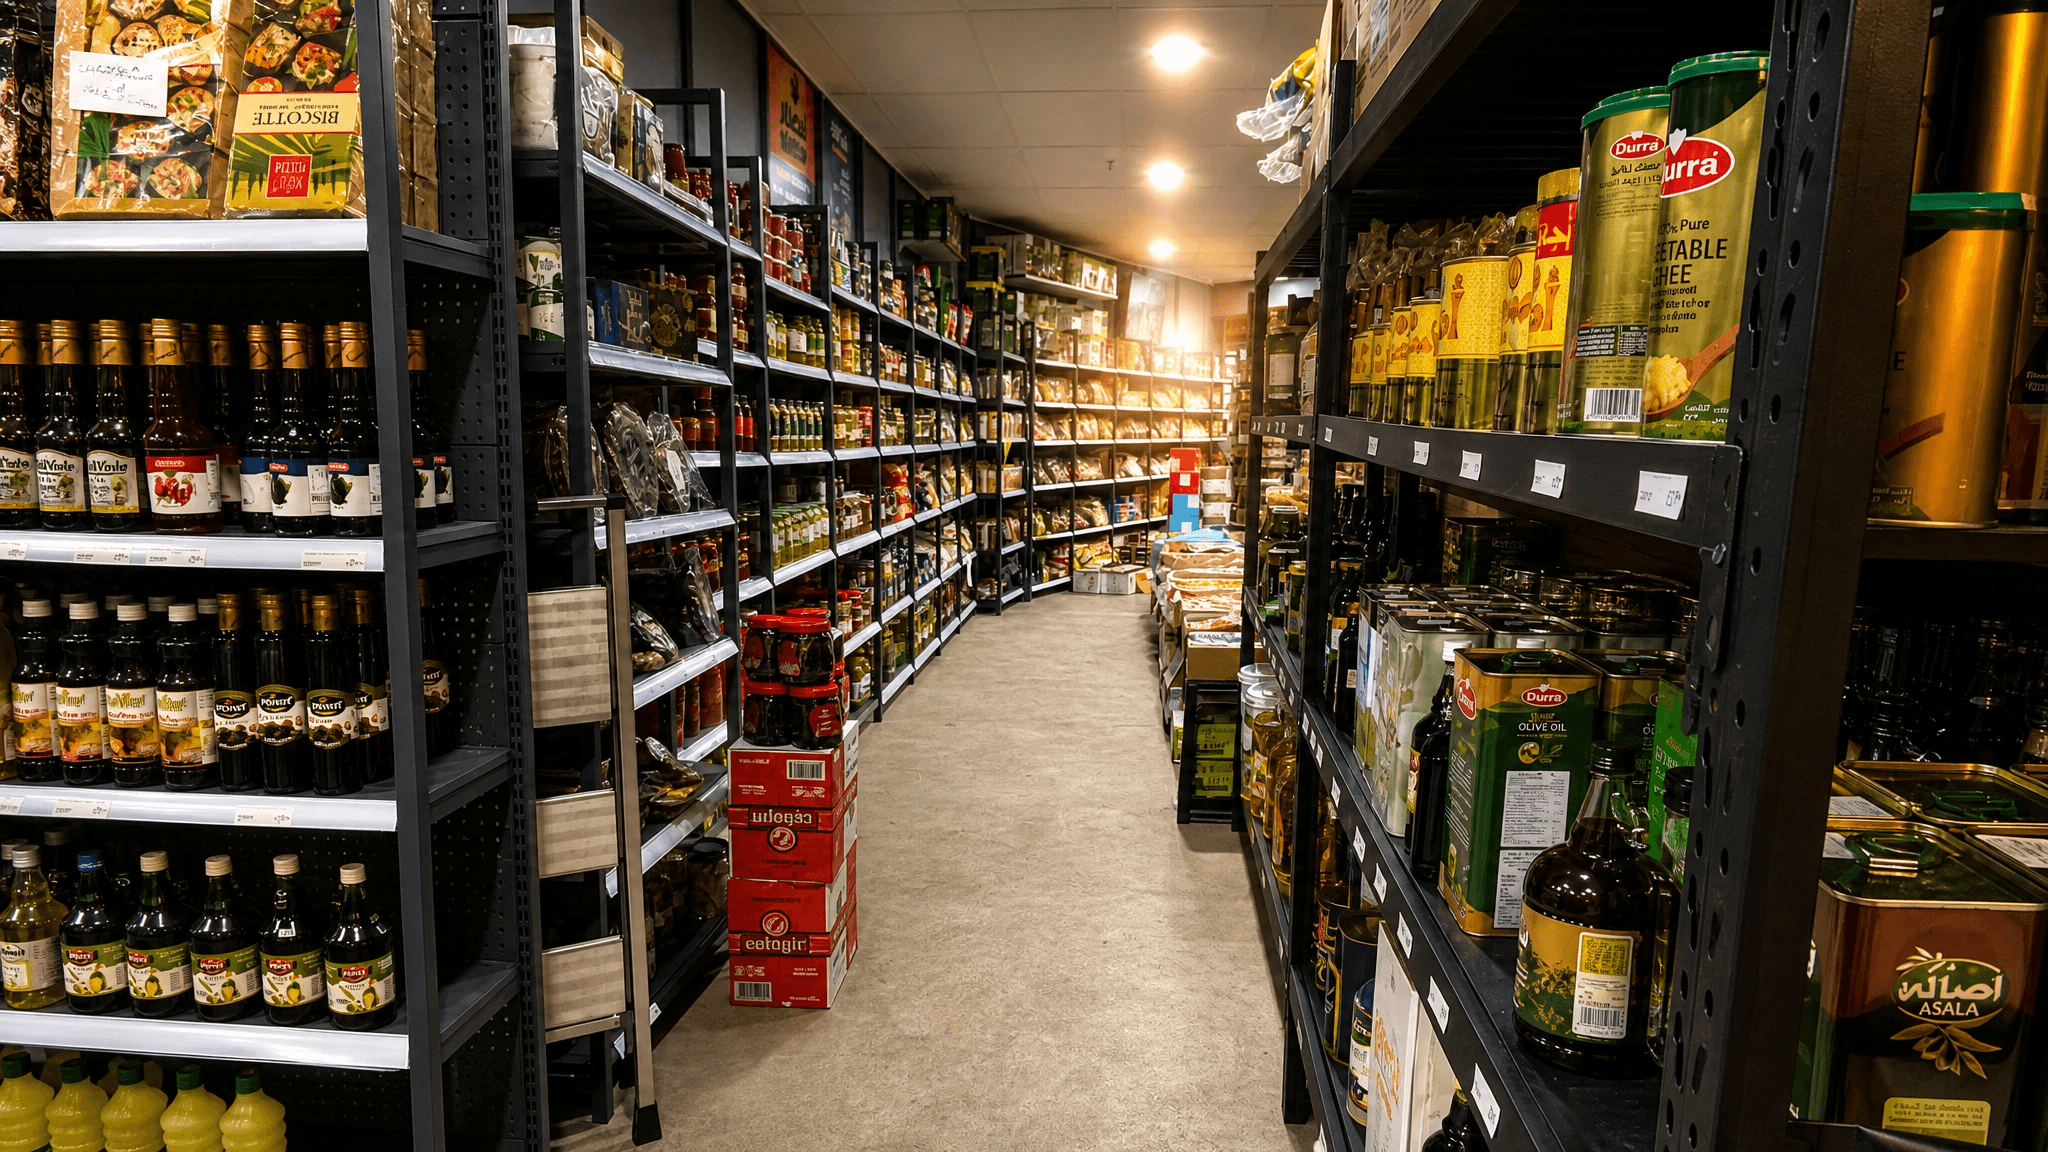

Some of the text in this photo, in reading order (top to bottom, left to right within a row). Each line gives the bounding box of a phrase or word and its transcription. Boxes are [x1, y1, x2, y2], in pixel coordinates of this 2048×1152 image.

[252, 110, 339, 126] BISCOTTE
[1680, 218, 1710, 232] Pure
[1526, 692, 1562, 703] Durra
[1518, 722, 1567, 732] OLIVE OIL
[1918, 1002, 1980, 1016] ASALA
